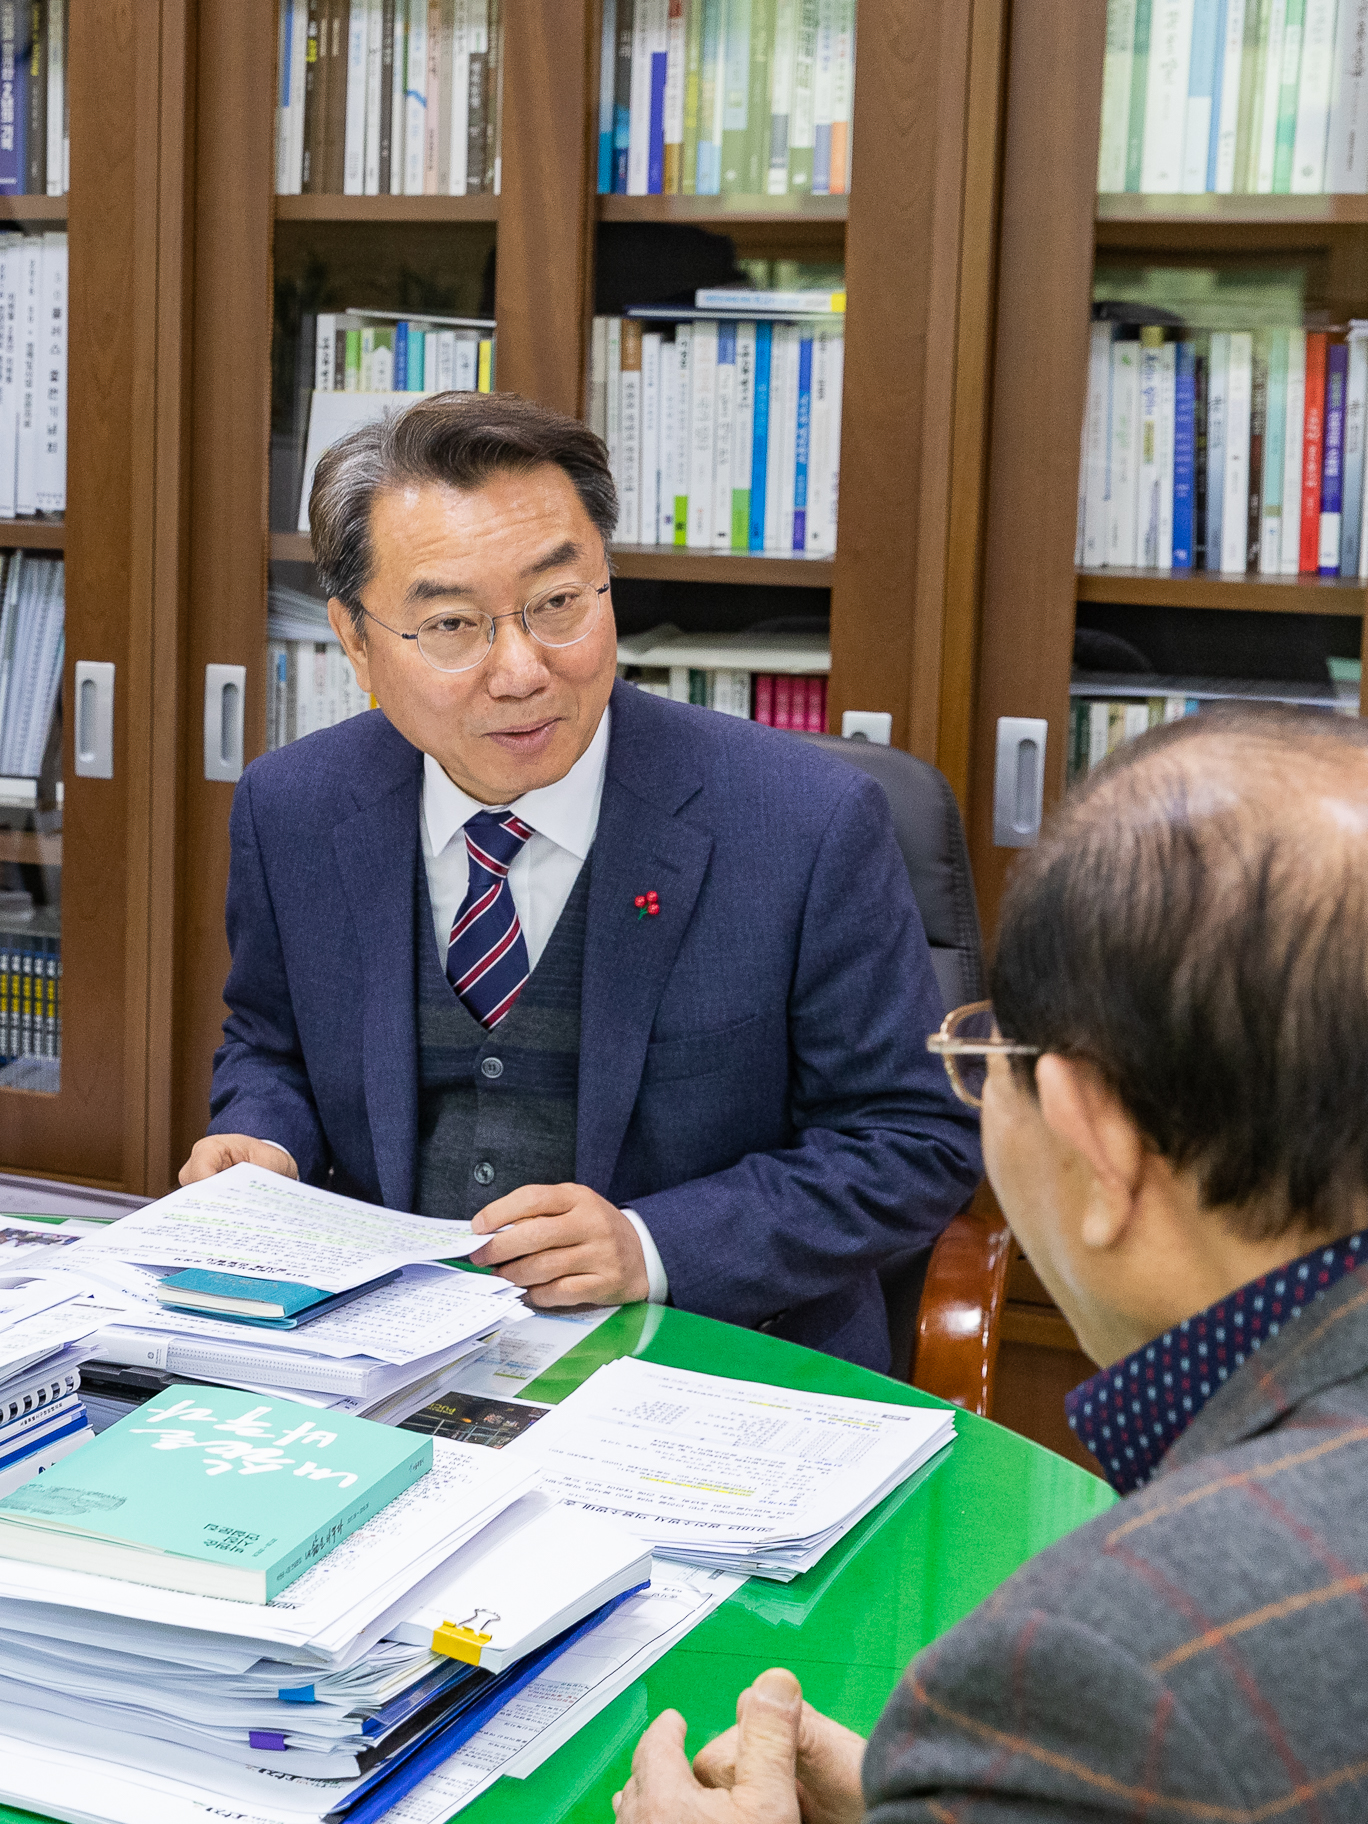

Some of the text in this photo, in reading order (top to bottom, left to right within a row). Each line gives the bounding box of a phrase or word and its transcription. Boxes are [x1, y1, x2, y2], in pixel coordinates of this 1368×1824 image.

[292, 1460, 359, 1489] 내
[203, 1523, 260, 1542] 연설문집
[203, 1538, 244, 1554] 박원순
[223, 1536, 254, 1547] 시장
